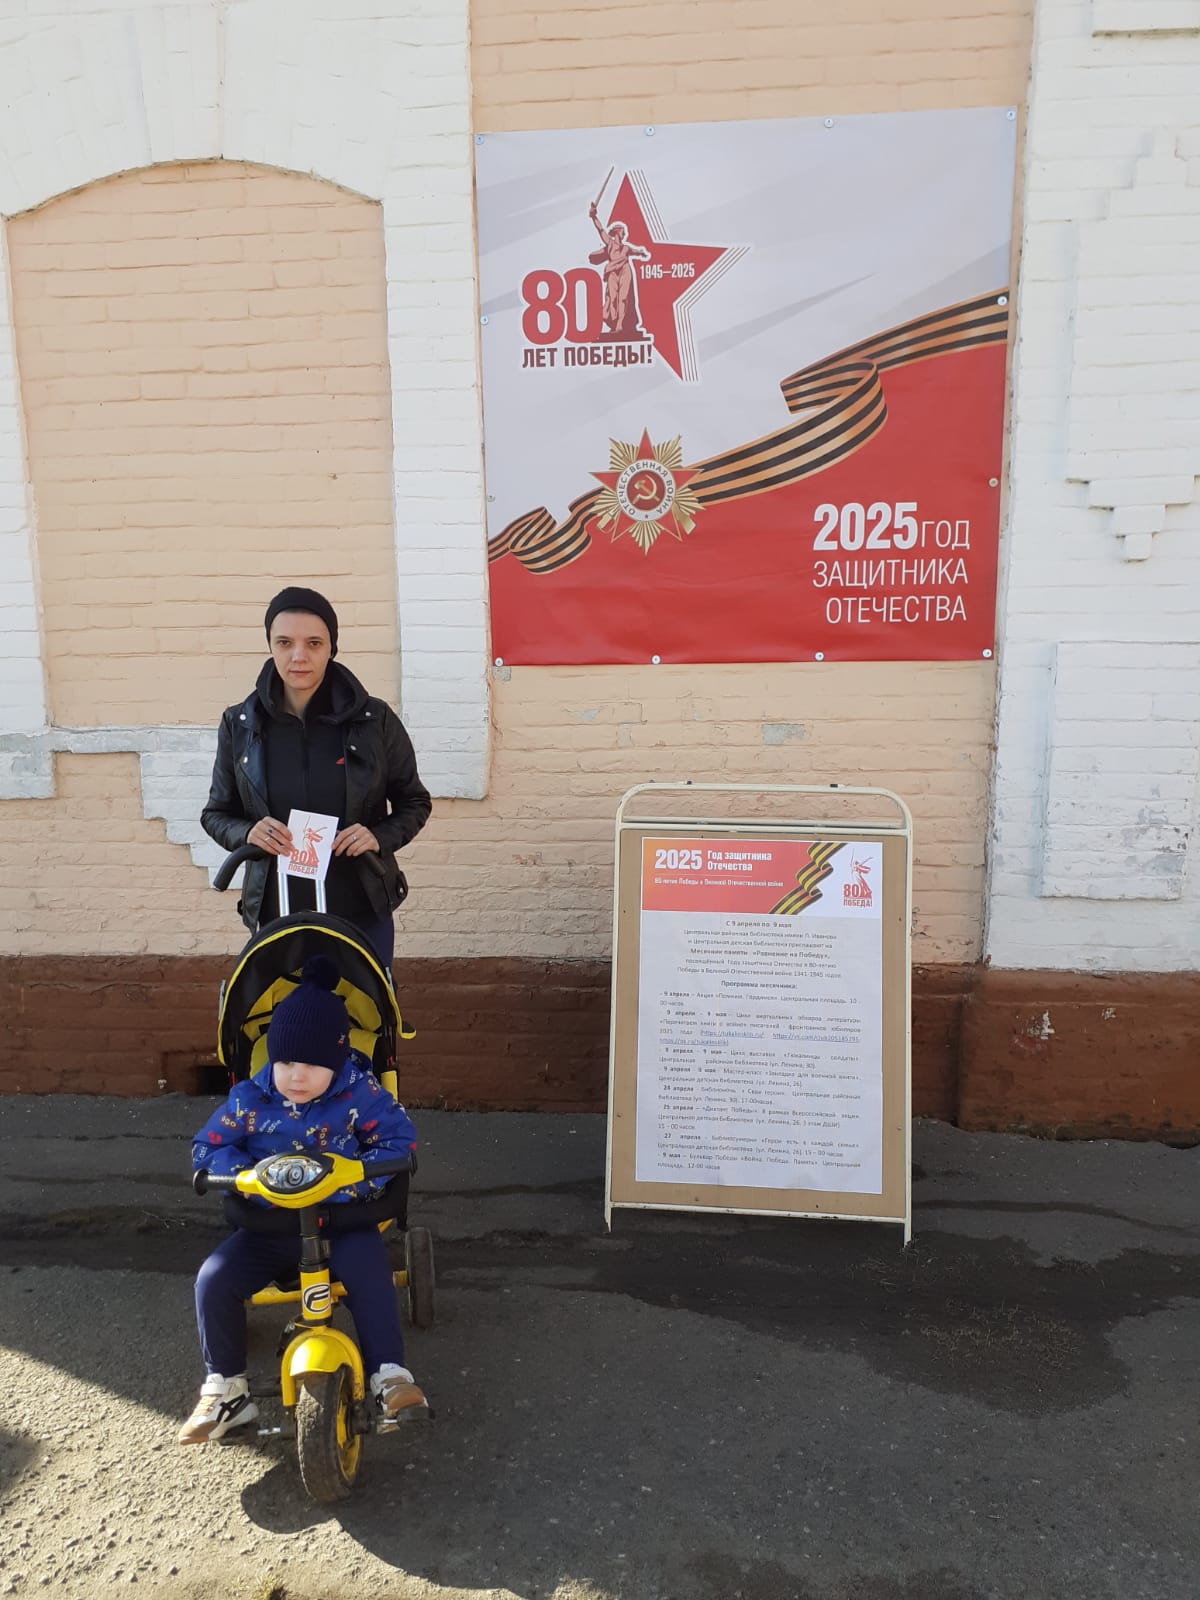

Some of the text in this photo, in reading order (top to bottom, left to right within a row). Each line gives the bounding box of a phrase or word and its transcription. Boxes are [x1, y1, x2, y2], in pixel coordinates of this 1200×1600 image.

[522, 268, 603, 345] 80
[522, 344, 653, 368] ЛЕТ ПОБЕДЫ!
[618, 461, 669, 516] ОТЕЧЕСТВЕННАЯ
[813, 501, 970, 551] 2025 ГОД
[812, 558, 969, 590] ЗАЩИТНИКА
[825, 595, 967, 624] ОТЕЧЕСТВА
[291, 849, 308, 862] 80
[655, 849, 772, 870] 2025 Год защитника
[288, 863, 318, 875] ПОБЕДА!
[707, 861, 753, 872] Отечества
[844, 884, 860, 897] 80
[843, 898, 873, 908] ПОБЕДА!
[721, 980, 758, 988] Программа
